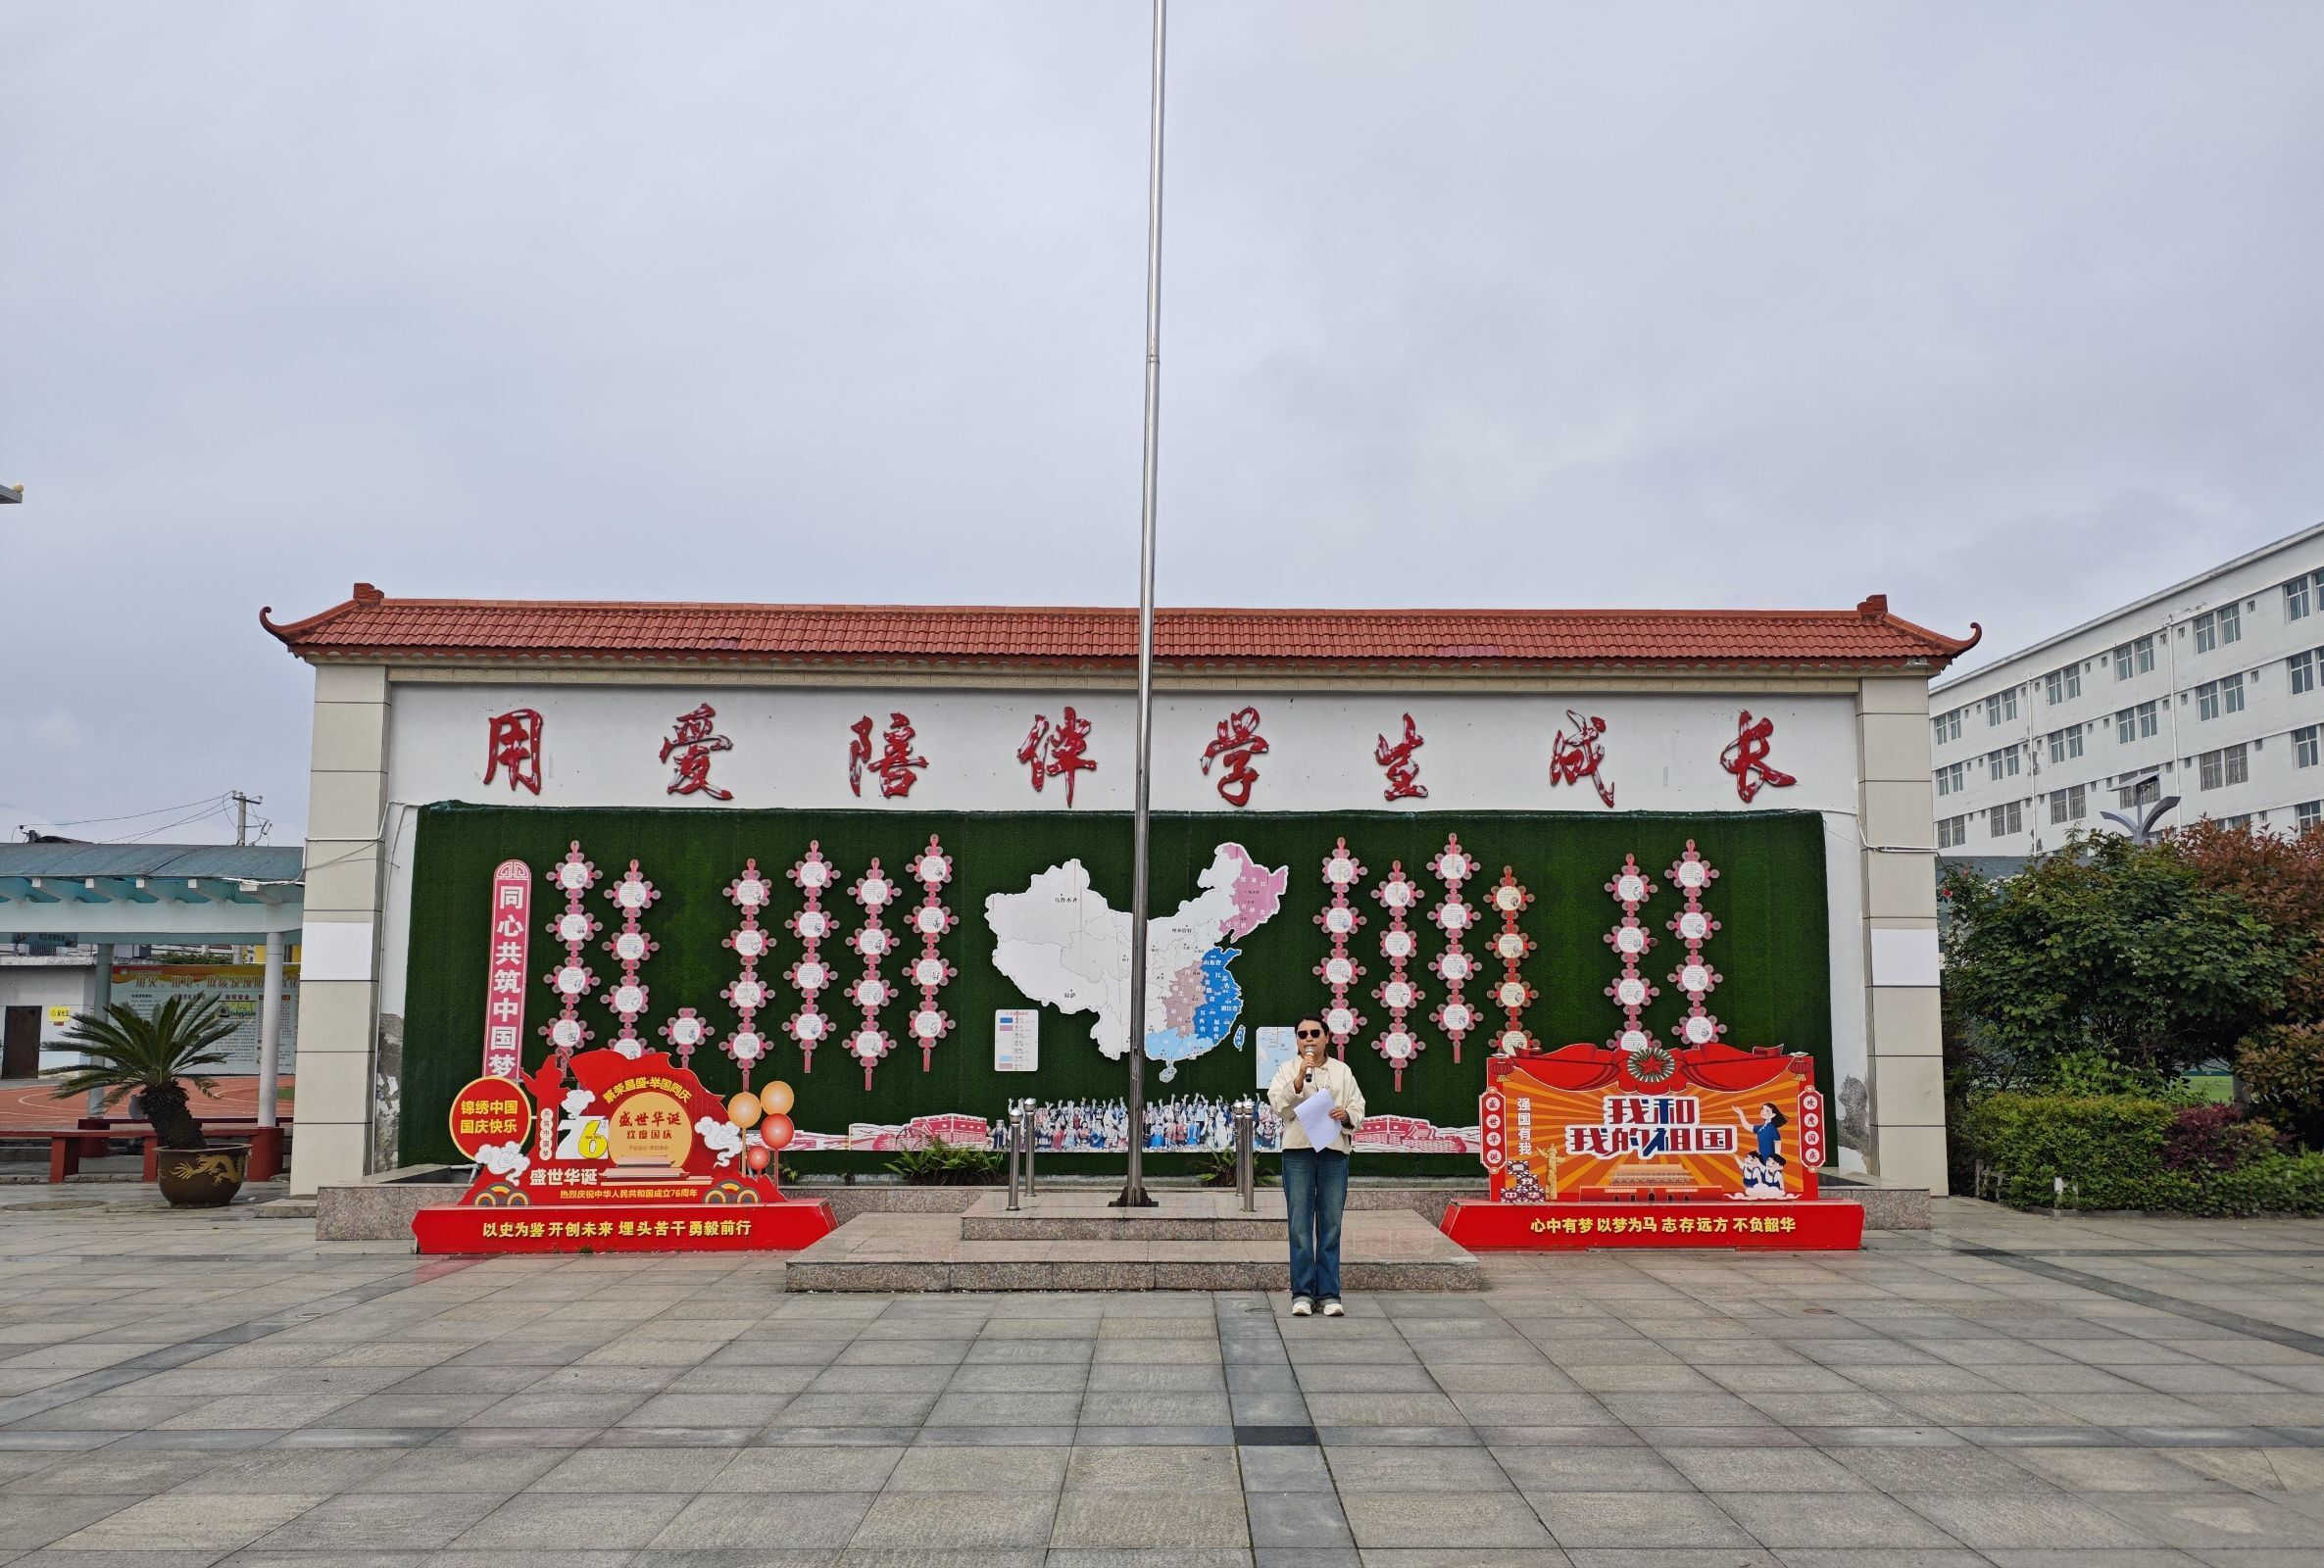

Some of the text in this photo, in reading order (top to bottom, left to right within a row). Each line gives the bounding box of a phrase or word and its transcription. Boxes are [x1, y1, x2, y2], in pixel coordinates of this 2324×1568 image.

[488, 885, 524, 1076] 同心共筑中国梦
[461, 1100, 519, 1115] 锦绣中国
[1607, 1098, 1698, 1125] 我和
[460, 1119, 518, 1135] 国庆快乐
[618, 1110, 682, 1128] 盛世华诞
[1516, 1097, 1532, 1155] 强国有我
[626, 1130, 672, 1140] 欢度国庆
[1489, 1098, 1500, 1161] 盛世华诞
[1806, 1098, 1818, 1161] 欢度国庆
[1569, 1127, 1733, 1156] 我的祖国
[529, 1168, 598, 1186] 盛世华诞
[560, 1188, 698, 1200] 热烈庆祝中华人民共和国成立76周年
[482, 1219, 752, 1238] 以史为鉴 开创未来 埋头苦干 勇毅前行
[1530, 1217, 1796, 1234] 心中有梦 以梦为马 志存远方 不负韶华
